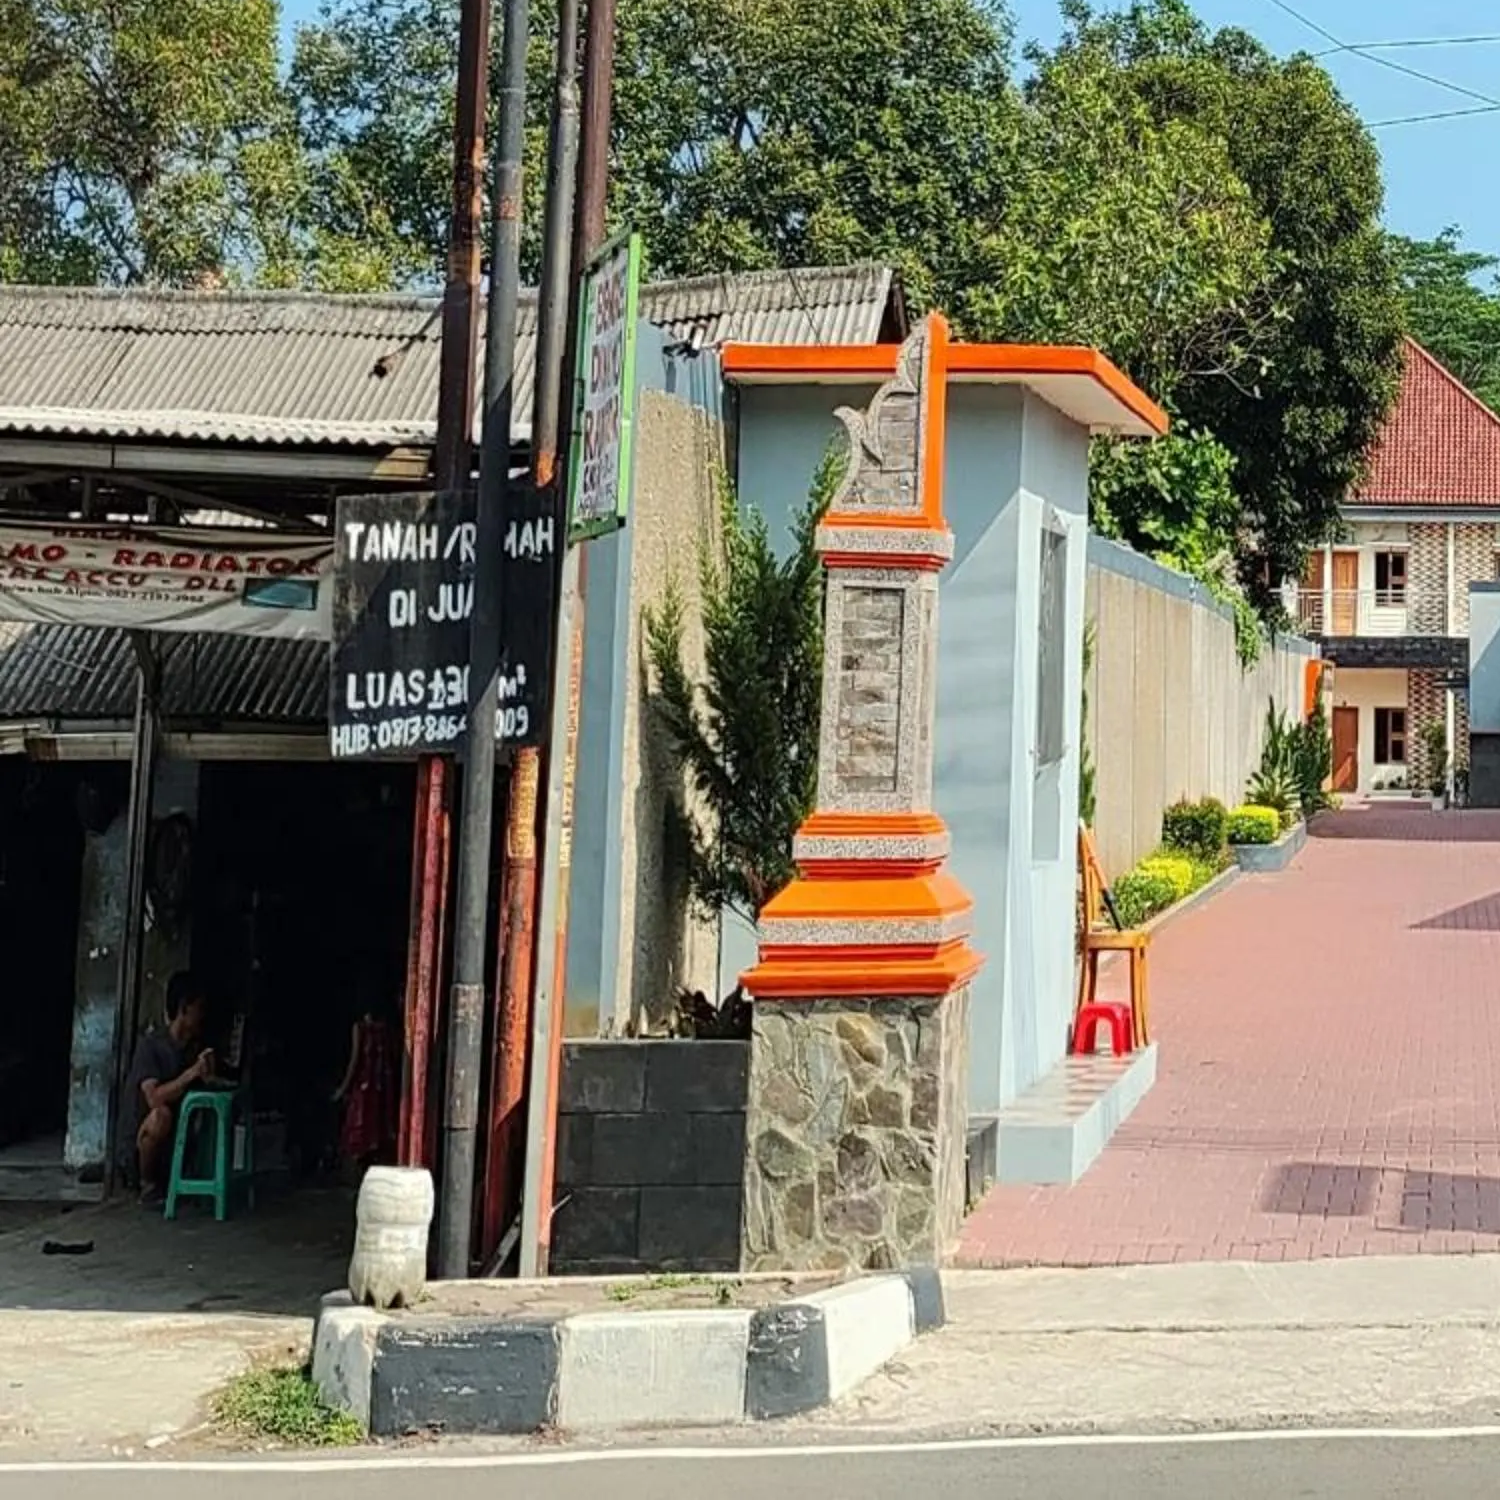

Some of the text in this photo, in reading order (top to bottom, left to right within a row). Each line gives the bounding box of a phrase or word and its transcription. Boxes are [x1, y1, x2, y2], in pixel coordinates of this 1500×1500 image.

[345, 520, 438, 562] TANAH
[112, 548, 321, 576] RADIATOR
[184, 575, 237, 592] DLL
[389, 588, 416, 628] DI
[347, 669, 427, 709] LUAS
